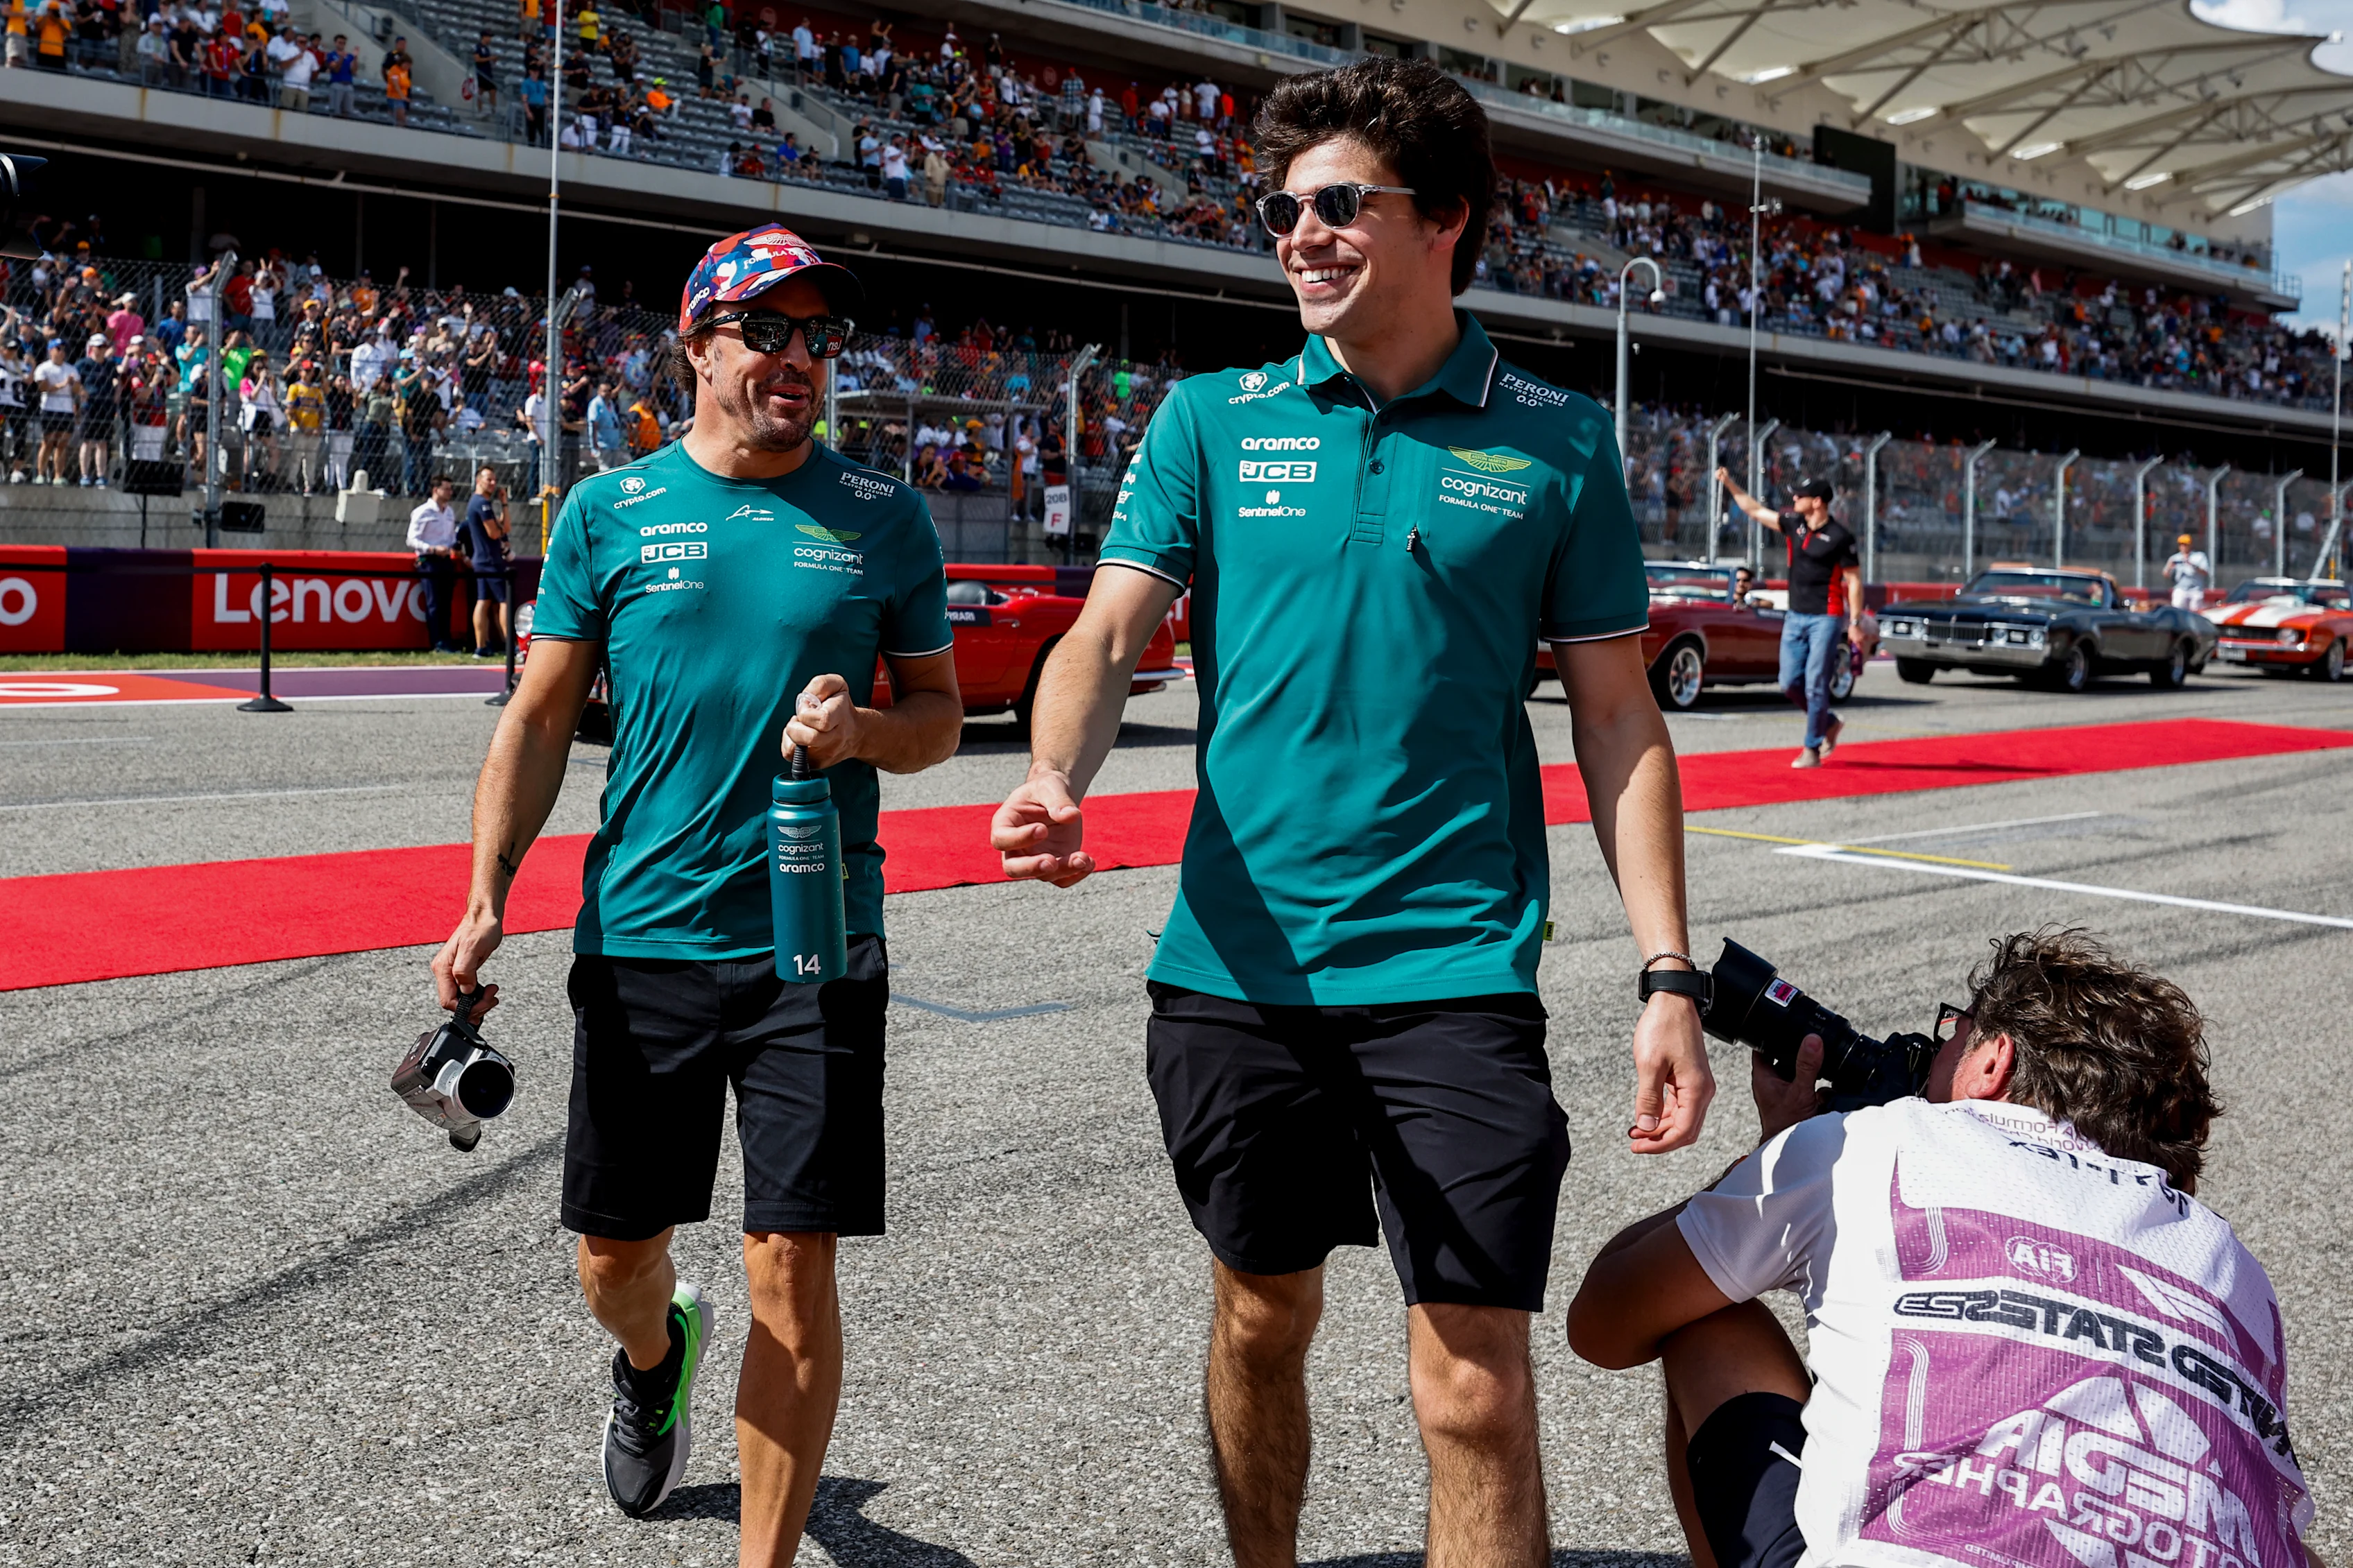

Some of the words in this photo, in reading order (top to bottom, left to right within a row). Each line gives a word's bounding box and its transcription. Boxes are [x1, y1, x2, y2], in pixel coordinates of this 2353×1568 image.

[685, 287, 710, 318] aramco
[1228, 381, 1290, 404] crypto.com
[1498, 381, 1527, 395] NASTRO
[1528, 393, 1564, 407] AZZURRO
[1502, 372, 1570, 403] PERONI
[1241, 437, 1321, 451] aramco
[1471, 454, 1488, 462] ASTON
[1488, 457, 1507, 465] MARTIN
[1242, 463, 1313, 480] JCB
[839, 480, 863, 490] NASTRO
[864, 488, 893, 498] AZZURRO
[840, 472, 895, 494] PERONI
[1441, 476, 1528, 505] cognizant
[614, 486, 667, 510] crypto.com
[1439, 494, 1479, 510] FORMULA
[1502, 508, 1523, 520] TEAM
[1050, 512, 1063, 528] F
[1238, 506, 1306, 517] SentinelOne
[640, 522, 708, 537] aramco
[643, 543, 706, 562] JCB
[794, 547, 864, 565] cognizant
[794, 561, 828, 571] FORMULA
[846, 567, 864, 576] TEAM
[645, 580, 704, 594] SentinelOne
[948, 610, 976, 621] RRARI
[778, 842, 824, 856] cognizant
[779, 862, 825, 873] aramco
[793, 954, 821, 976] 14
